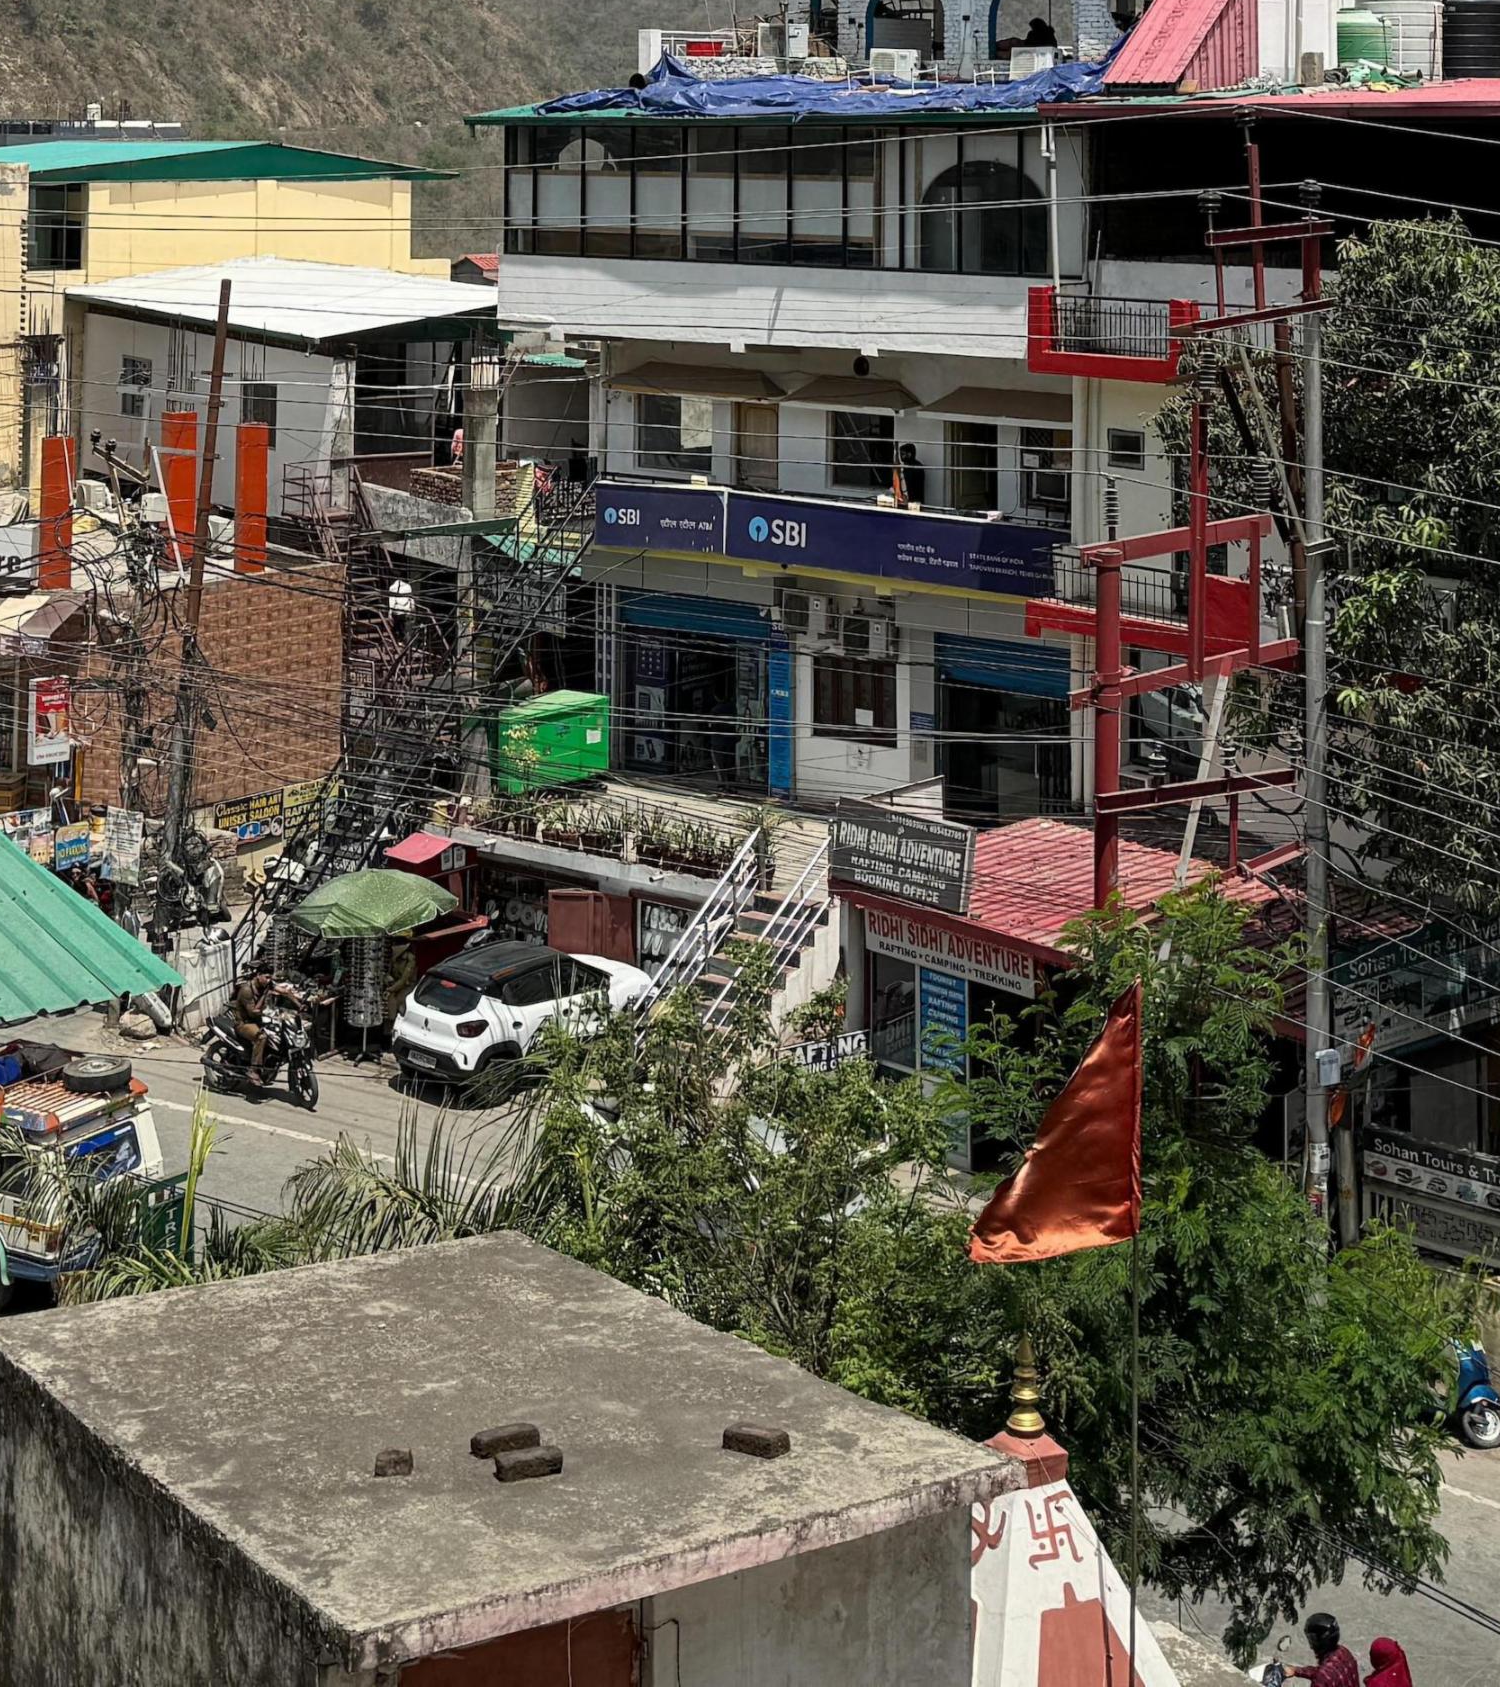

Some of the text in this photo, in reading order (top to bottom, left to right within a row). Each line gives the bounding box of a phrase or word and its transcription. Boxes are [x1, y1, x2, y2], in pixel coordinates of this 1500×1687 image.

[617, 508, 641, 526] SBI
[698, 521, 714, 531] ATM
[771, 519, 807, 548] SBI
[218, 805, 280, 828] UNISEX SALOON
[249, 797, 267, 810] HAIR
[840, 819, 869, 848] RIDHI
[869, 830, 898, 860] SIDHI
[900, 838, 962, 878] ADVENTURE
[851, 855, 946, 891] RAFTING CAMPING
[854, 868, 940, 904] BOOKING OFFICE
[867, 911, 1031, 981] RIDHI SIDHI ADVENTURE
[878, 939, 1022, 992] RAFTING CAMPING TREKKING
[1349, 952, 1397, 980] Sohan
[794, 1033, 868, 1065] AFTING
[1373, 1137, 1420, 1164] Sohan
[1422, 1150, 1465, 1175] Tours
[1467, 1163, 1479, 1178] &
